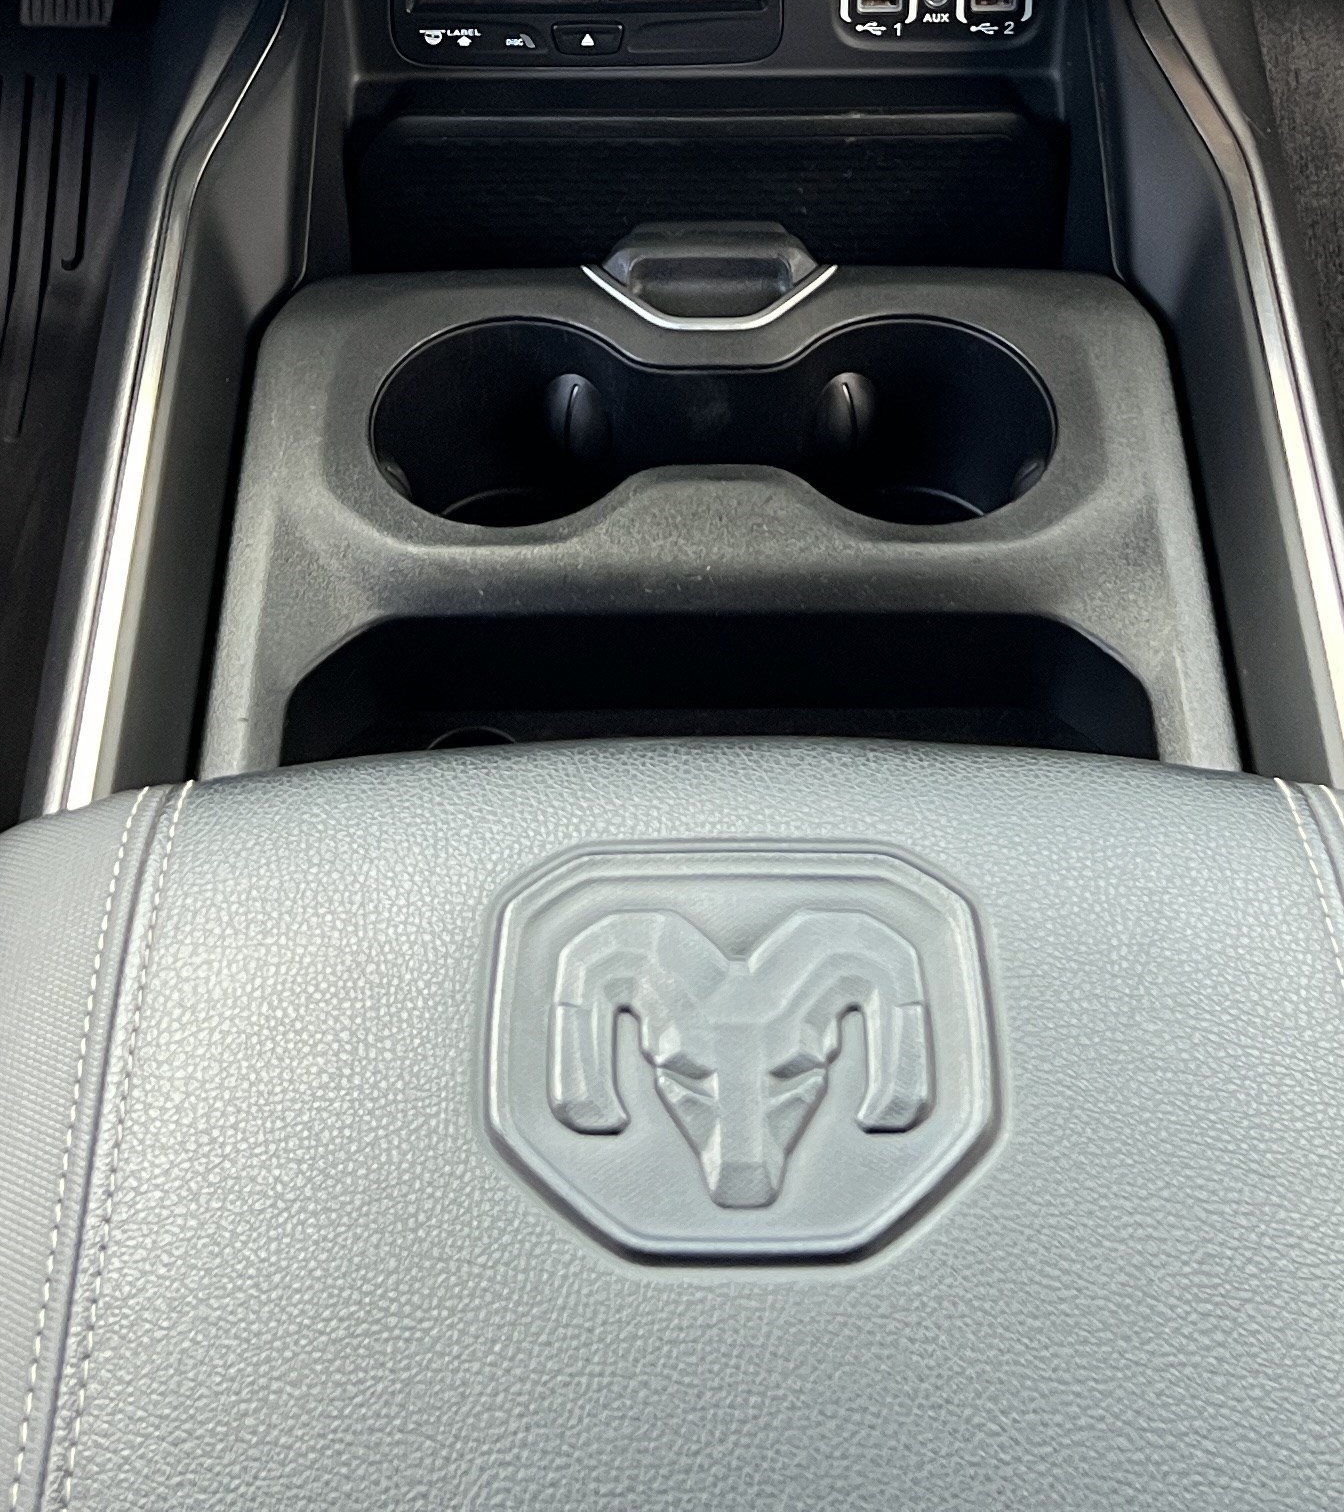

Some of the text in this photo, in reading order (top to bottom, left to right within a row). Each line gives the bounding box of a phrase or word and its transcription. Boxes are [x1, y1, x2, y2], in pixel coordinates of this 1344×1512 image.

[923, 13, 950, 24] AUX
[446, 28, 481, 37] LABEL
[894, 22, 902, 36] 1
[1004, 21, 1015, 35] 2
